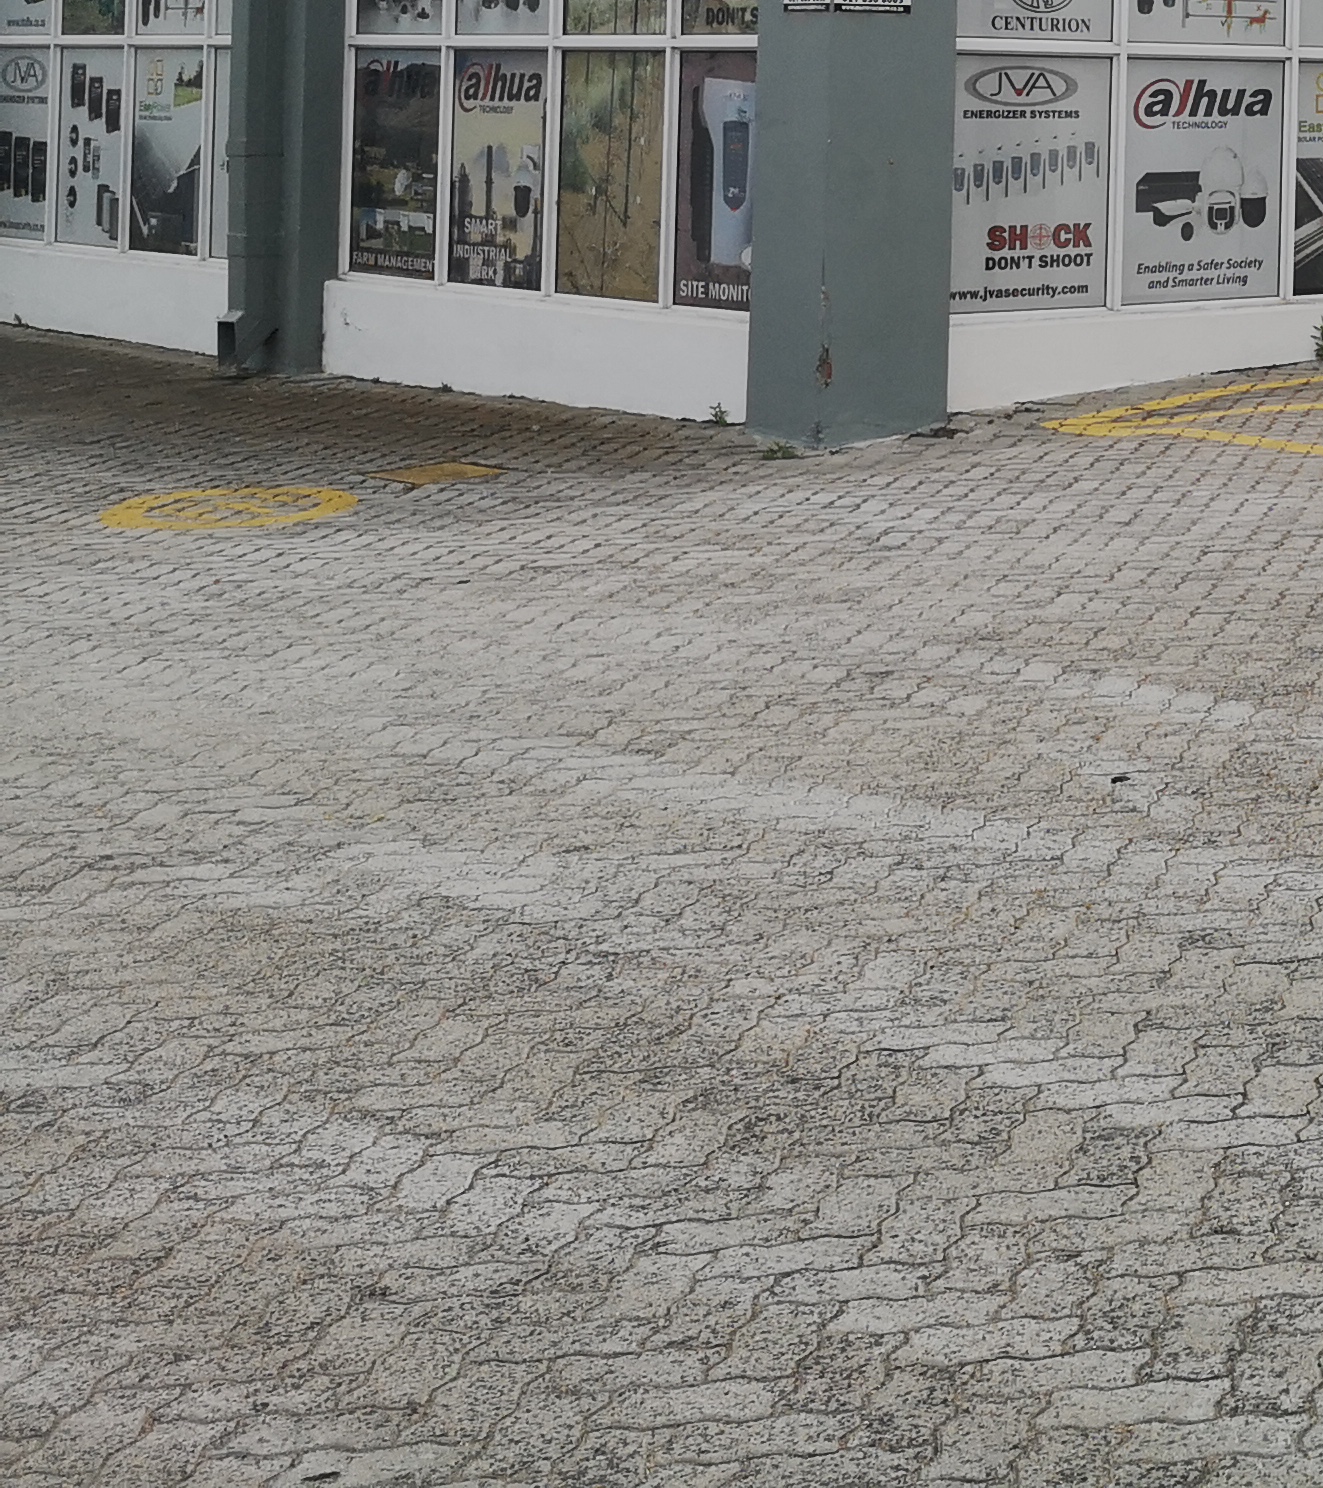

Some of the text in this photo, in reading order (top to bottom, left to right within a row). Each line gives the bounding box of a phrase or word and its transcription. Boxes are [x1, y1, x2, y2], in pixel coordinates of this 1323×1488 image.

[991, 15, 1091, 33] CENTURION
[12, 62, 39, 84] JVA
[989, 71, 1057, 97] JVA
[962, 109, 1080, 120] ENERGIZER SYSTEMS
[1172, 120, 1229, 130] TECHNOLOGY
[464, 217, 503, 235] SMART
[352, 250, 436, 273] FARM MANAGEMEN
[453, 245, 513, 262] INDUSTRIAL
[984, 252, 1094, 271] DON'T SHOOT
[1136, 258, 1264, 276] Enabling a Safer Society
[679, 279, 706, 298] SITE
[1147, 273, 1249, 290] and Smarter Living
